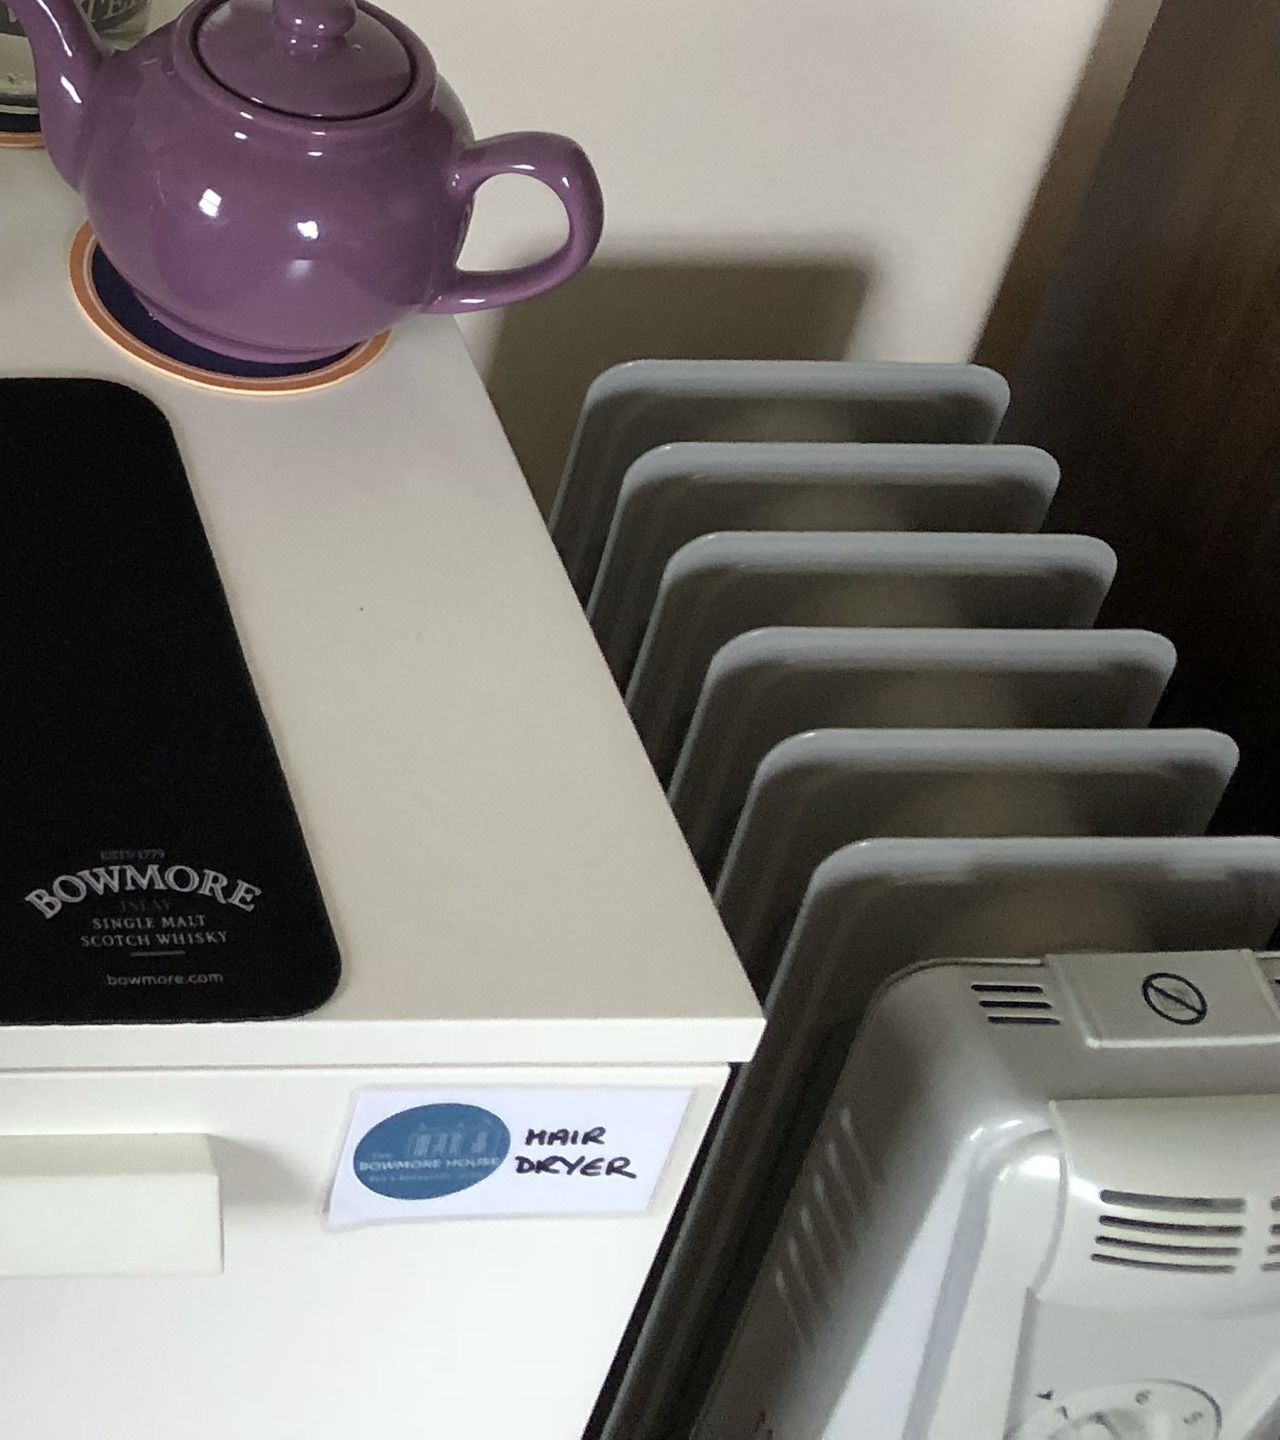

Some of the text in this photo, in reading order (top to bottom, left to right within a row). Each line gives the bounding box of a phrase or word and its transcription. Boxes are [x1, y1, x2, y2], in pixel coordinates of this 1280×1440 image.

[25, 864, 262, 919] BOWMORE
[92, 914, 207, 930] SINGLE MALT
[80, 931, 228, 948] SCOTCH WHISKY
[107, 972, 224, 986] bowmore.com
[524, 1126, 607, 1147] HAIR
[514, 1154, 638, 1180] DRYER
